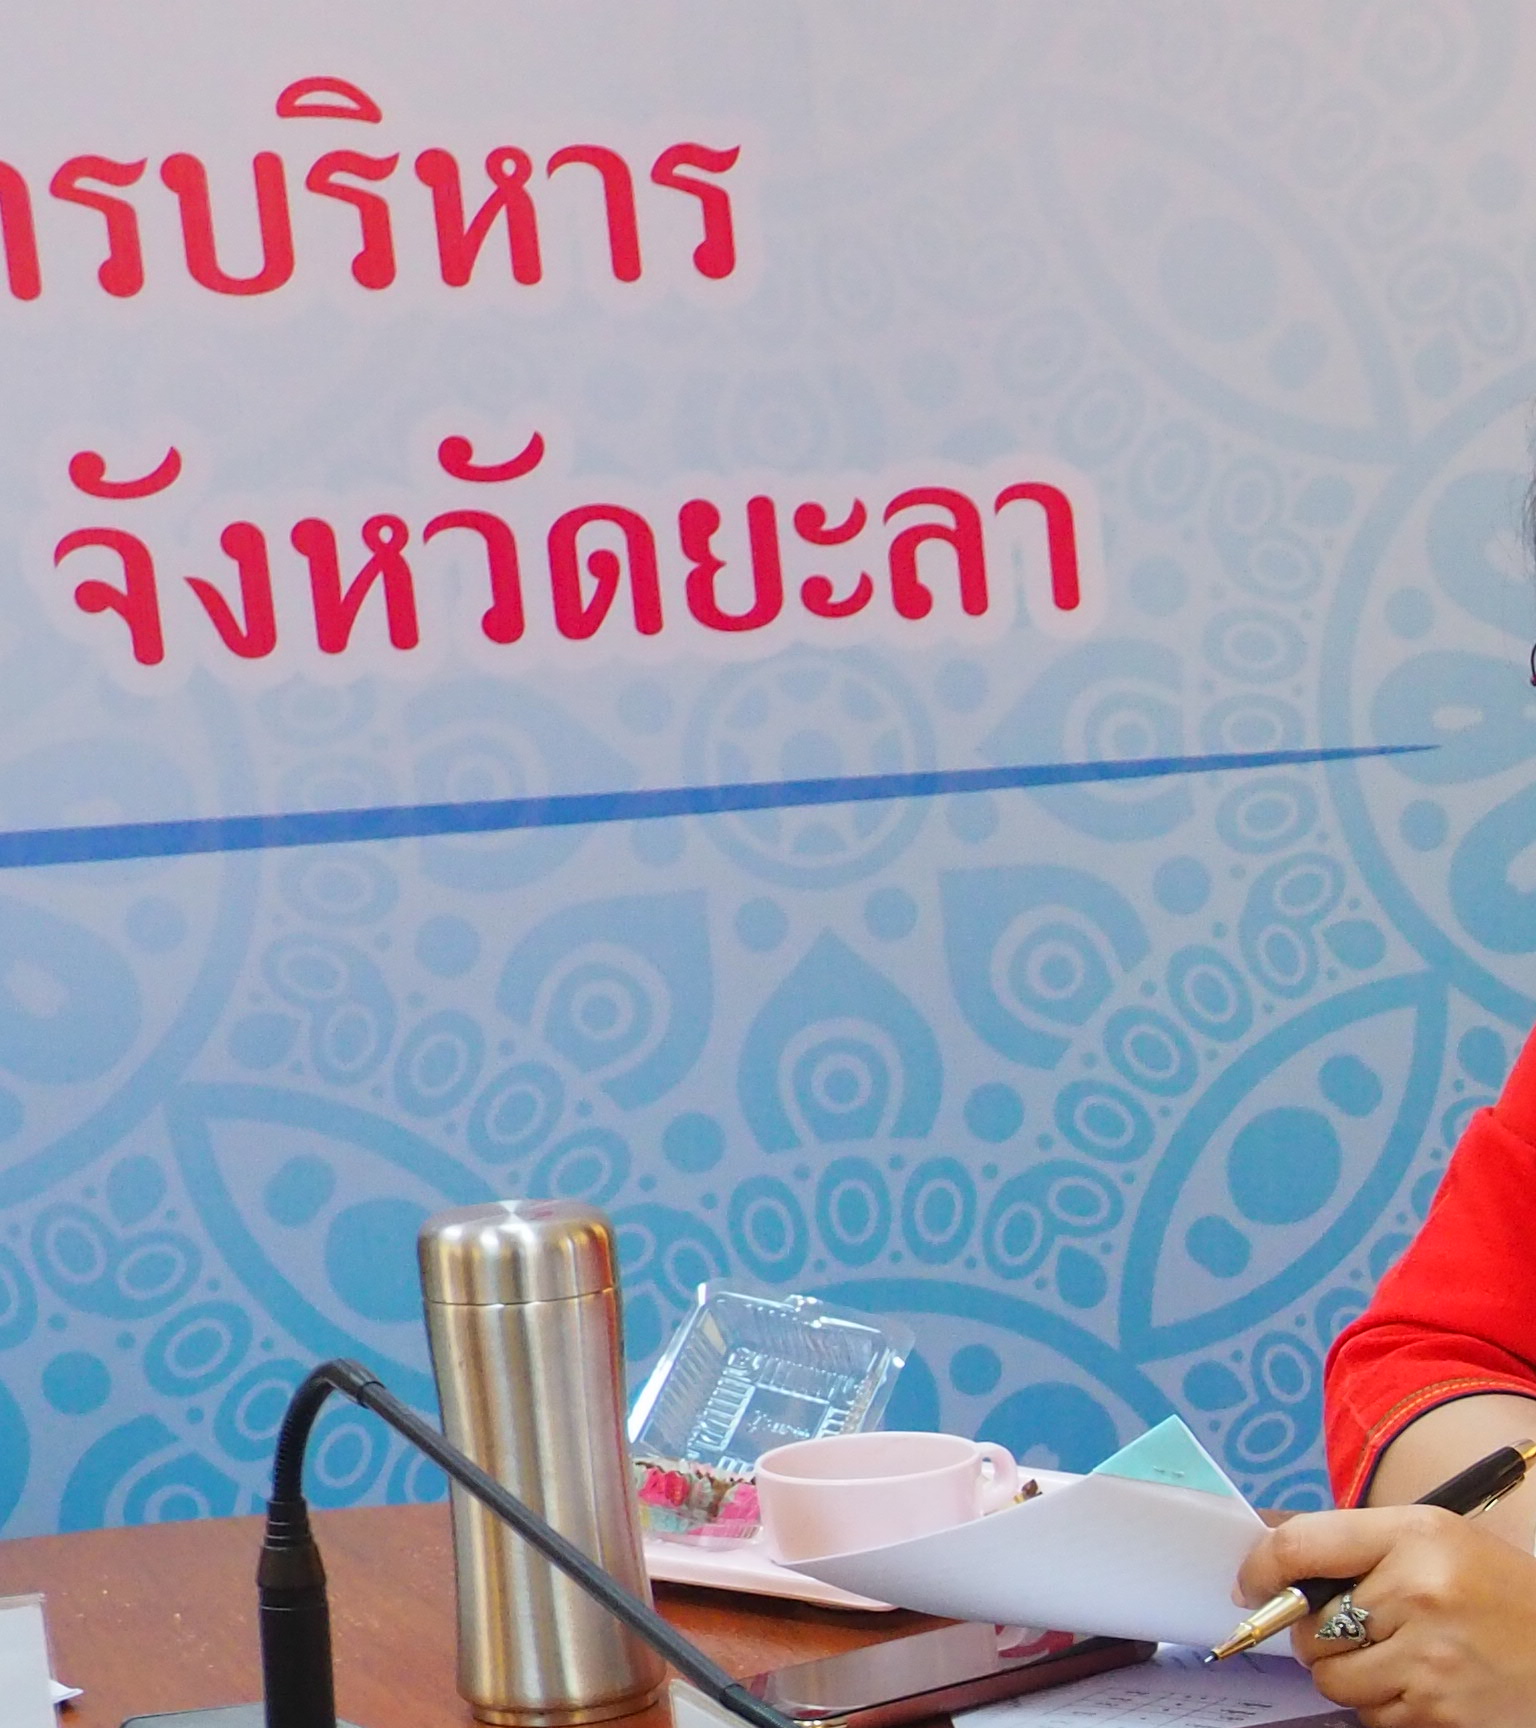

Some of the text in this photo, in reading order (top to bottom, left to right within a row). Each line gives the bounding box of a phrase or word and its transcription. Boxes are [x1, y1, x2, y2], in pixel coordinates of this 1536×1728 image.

[53, 432, 1081, 666] จังหวัดยะลา
